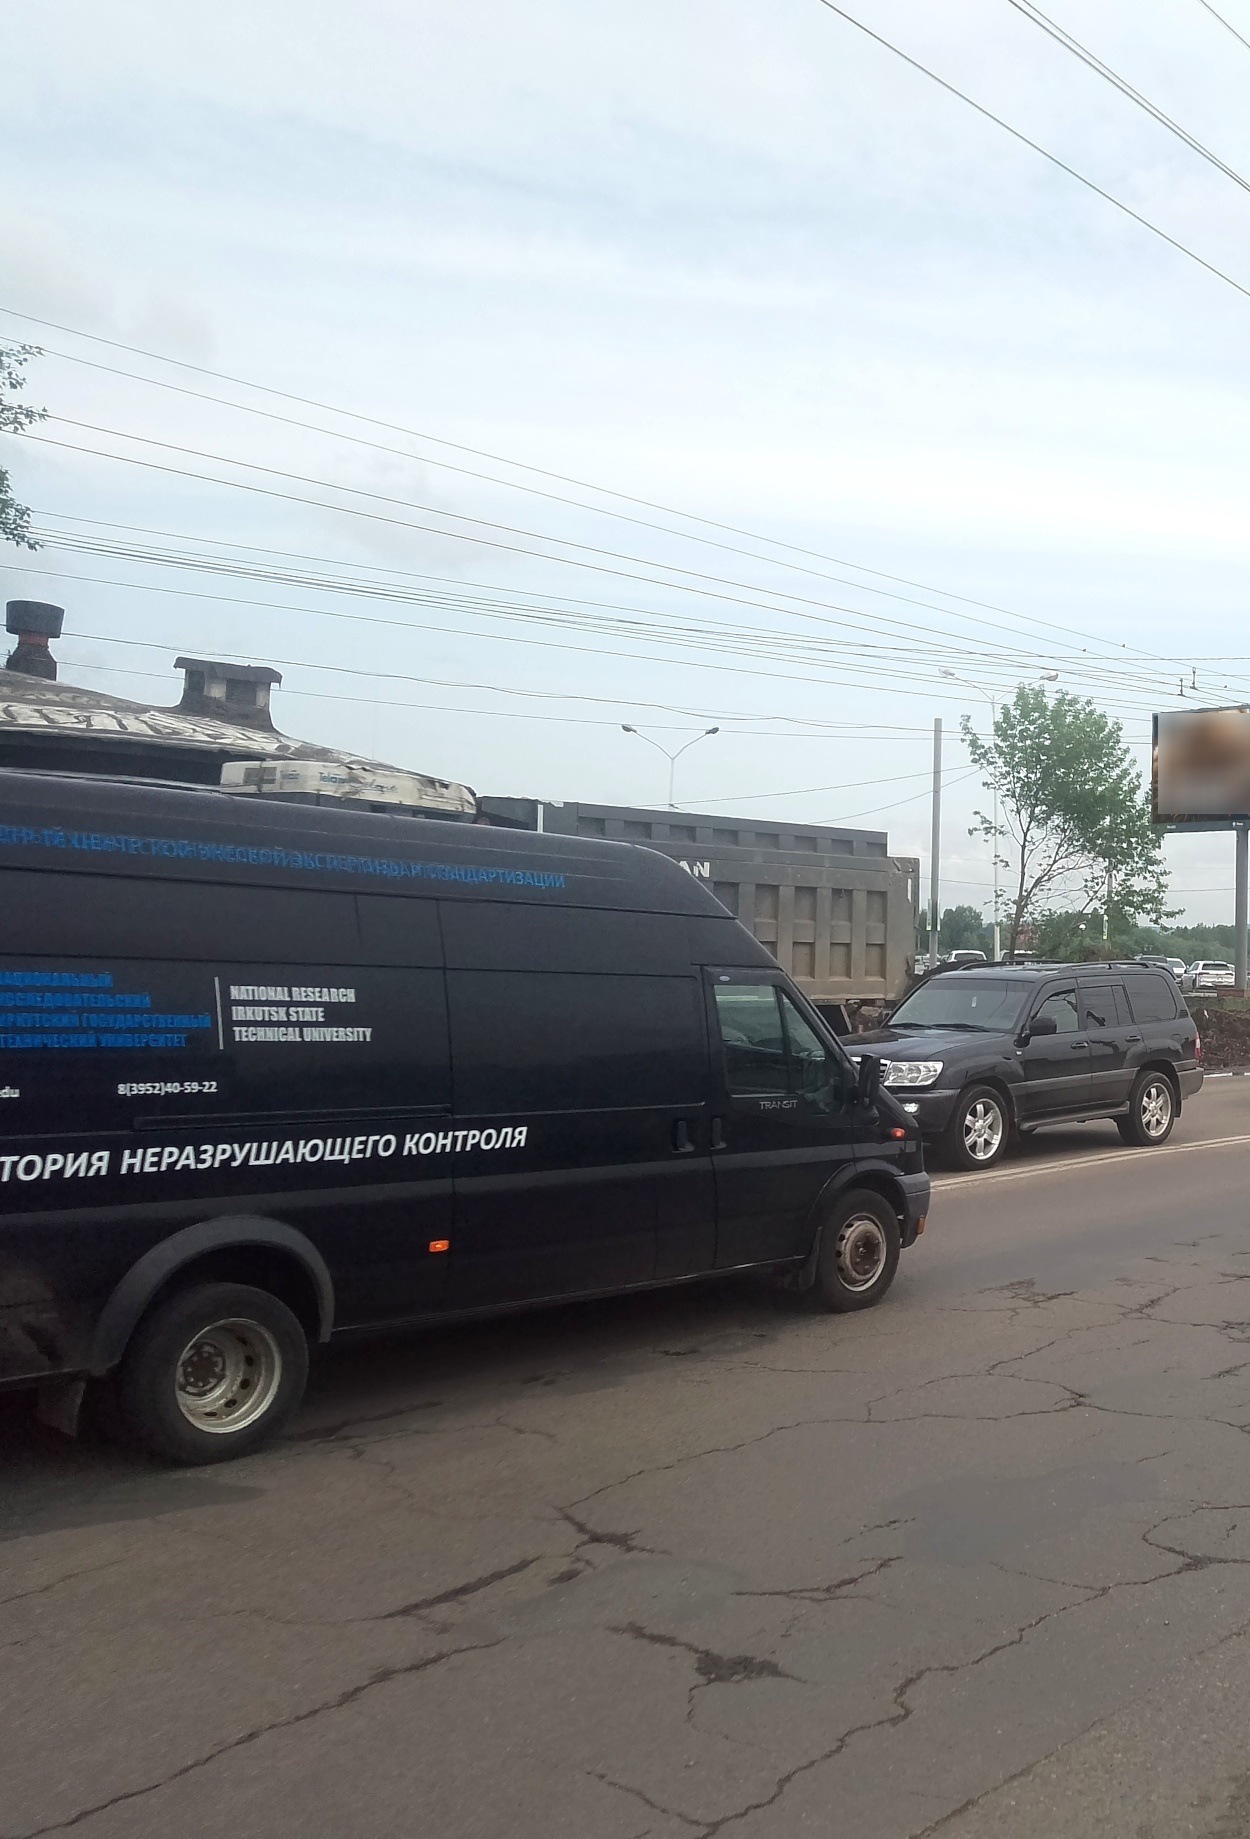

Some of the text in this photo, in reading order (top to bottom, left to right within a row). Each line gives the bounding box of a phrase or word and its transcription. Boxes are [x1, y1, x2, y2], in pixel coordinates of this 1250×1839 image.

[229, 985, 356, 1002] NATIONAL RESEARCH
[231, 1006, 326, 1021] IRKUTSK STATE
[232, 1026, 373, 1042] TECHNICAL UNIVERSITY
[759, 1100, 798, 1110] TRANSIT
[0, 1126, 528, 1182] ТОРИЯ НЕРАЗРУШАЮЩЕГО КОНТРОЛЯ
